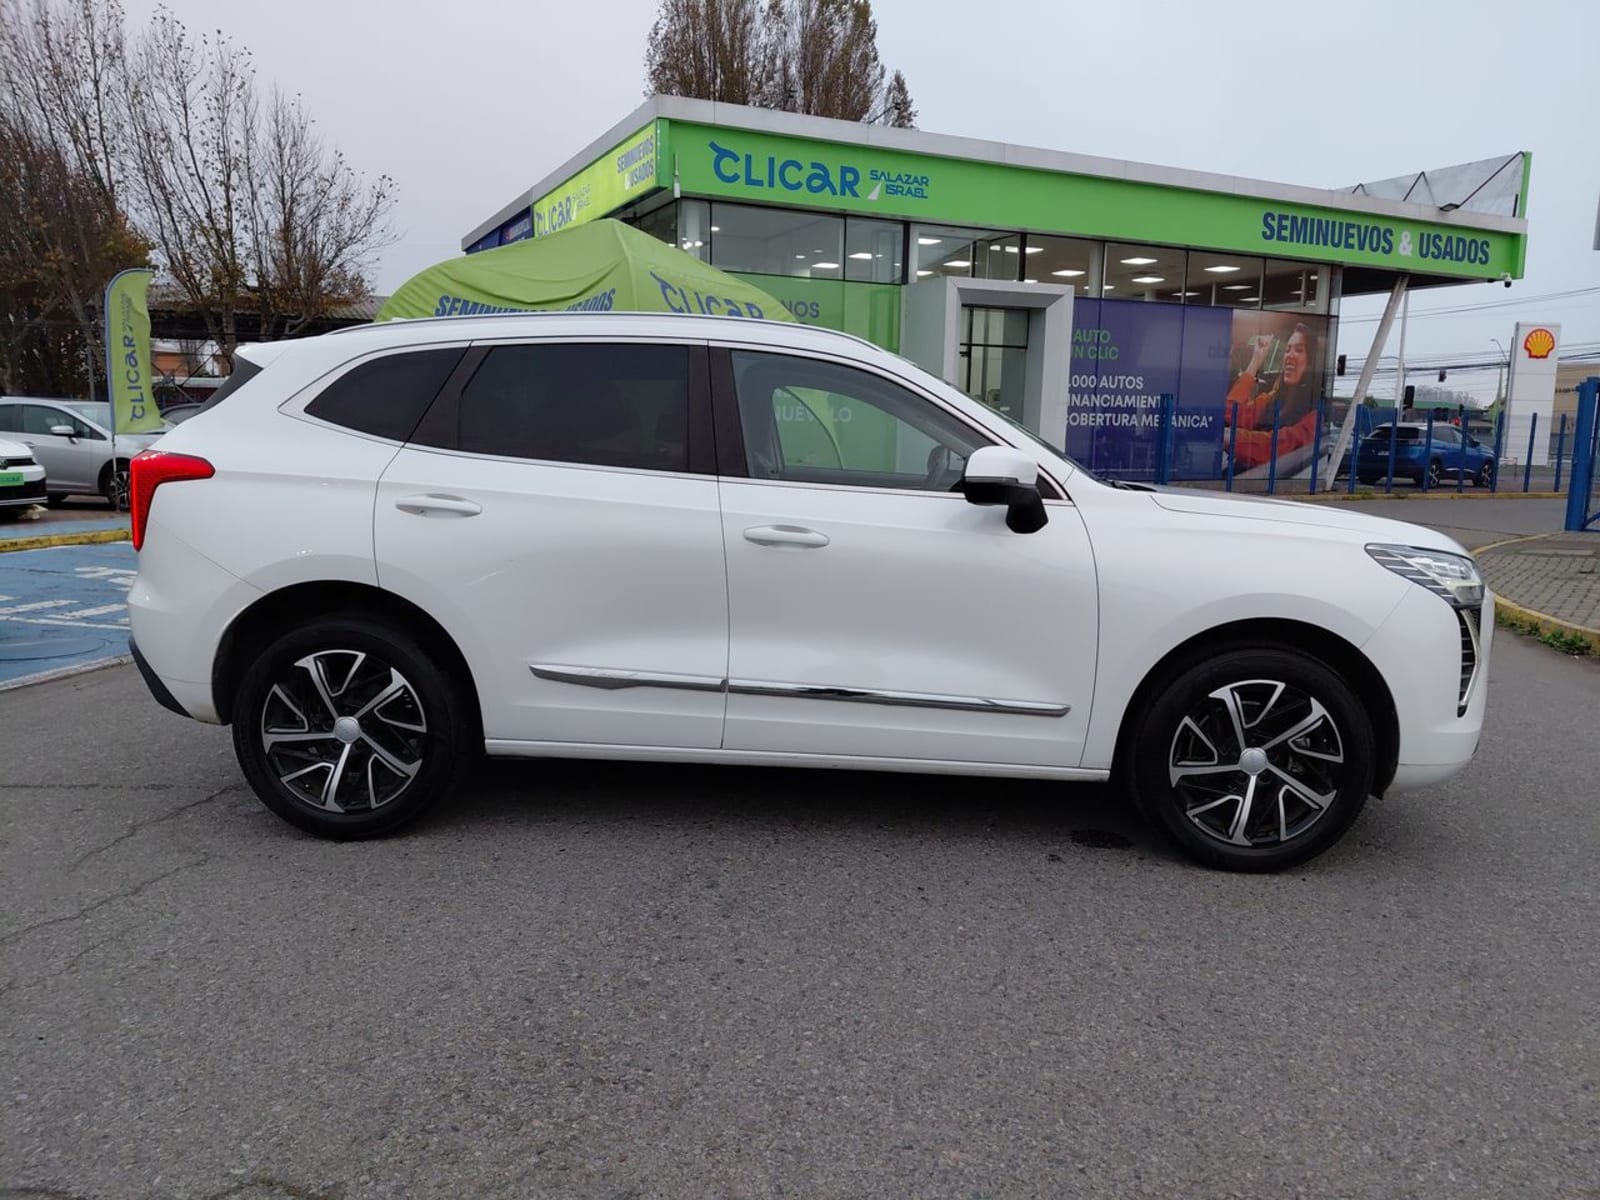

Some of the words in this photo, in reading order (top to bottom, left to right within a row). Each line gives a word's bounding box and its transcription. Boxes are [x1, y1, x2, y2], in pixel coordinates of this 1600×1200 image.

[870, 169, 929, 187] SALAZAR
[885, 184, 928, 199] ISRAEL
[1262, 212, 1393, 254] SEMINUEVOS
[1399, 230, 1413, 257] &
[1418, 232, 1490, 265] USADOS
[1073, 330, 1110, 343] AUTO
[1088, 347, 1119, 360] CLIC
[1099, 376, 1144, 390] AUTOS
[1065, 413, 1138, 427] OBERTURA
